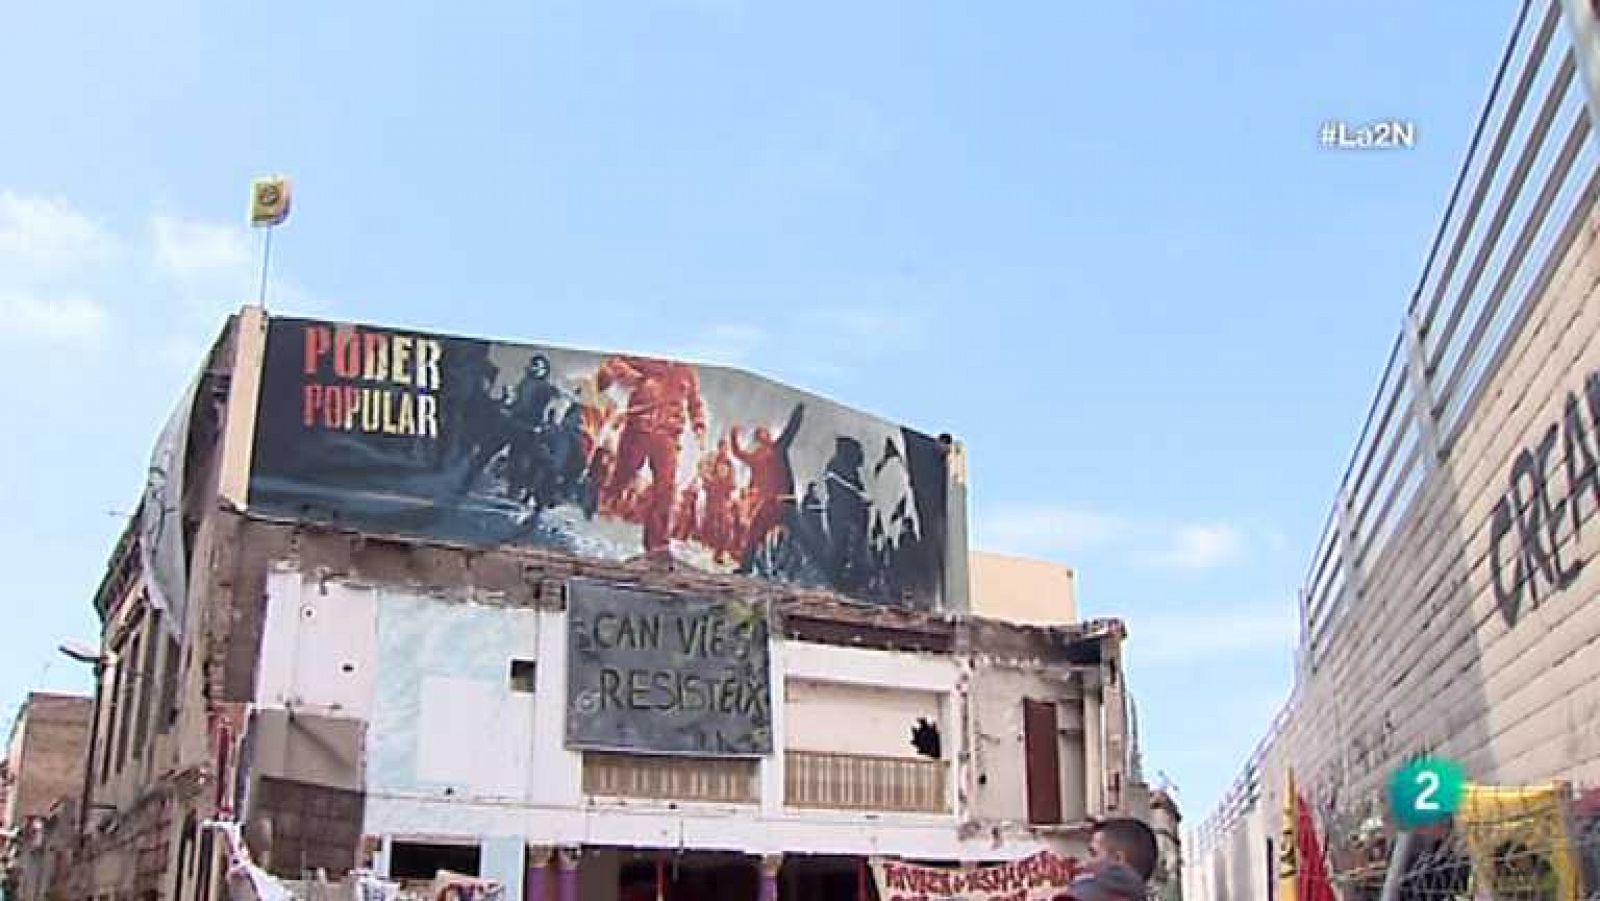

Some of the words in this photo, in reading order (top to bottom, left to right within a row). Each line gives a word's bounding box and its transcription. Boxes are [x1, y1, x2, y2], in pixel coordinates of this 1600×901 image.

[303, 326, 443, 390] PODER
[303, 384, 438, 438] POPULAR
[592, 612, 660, 651] CAN
[600, 666, 768, 717] RESISTEIX
